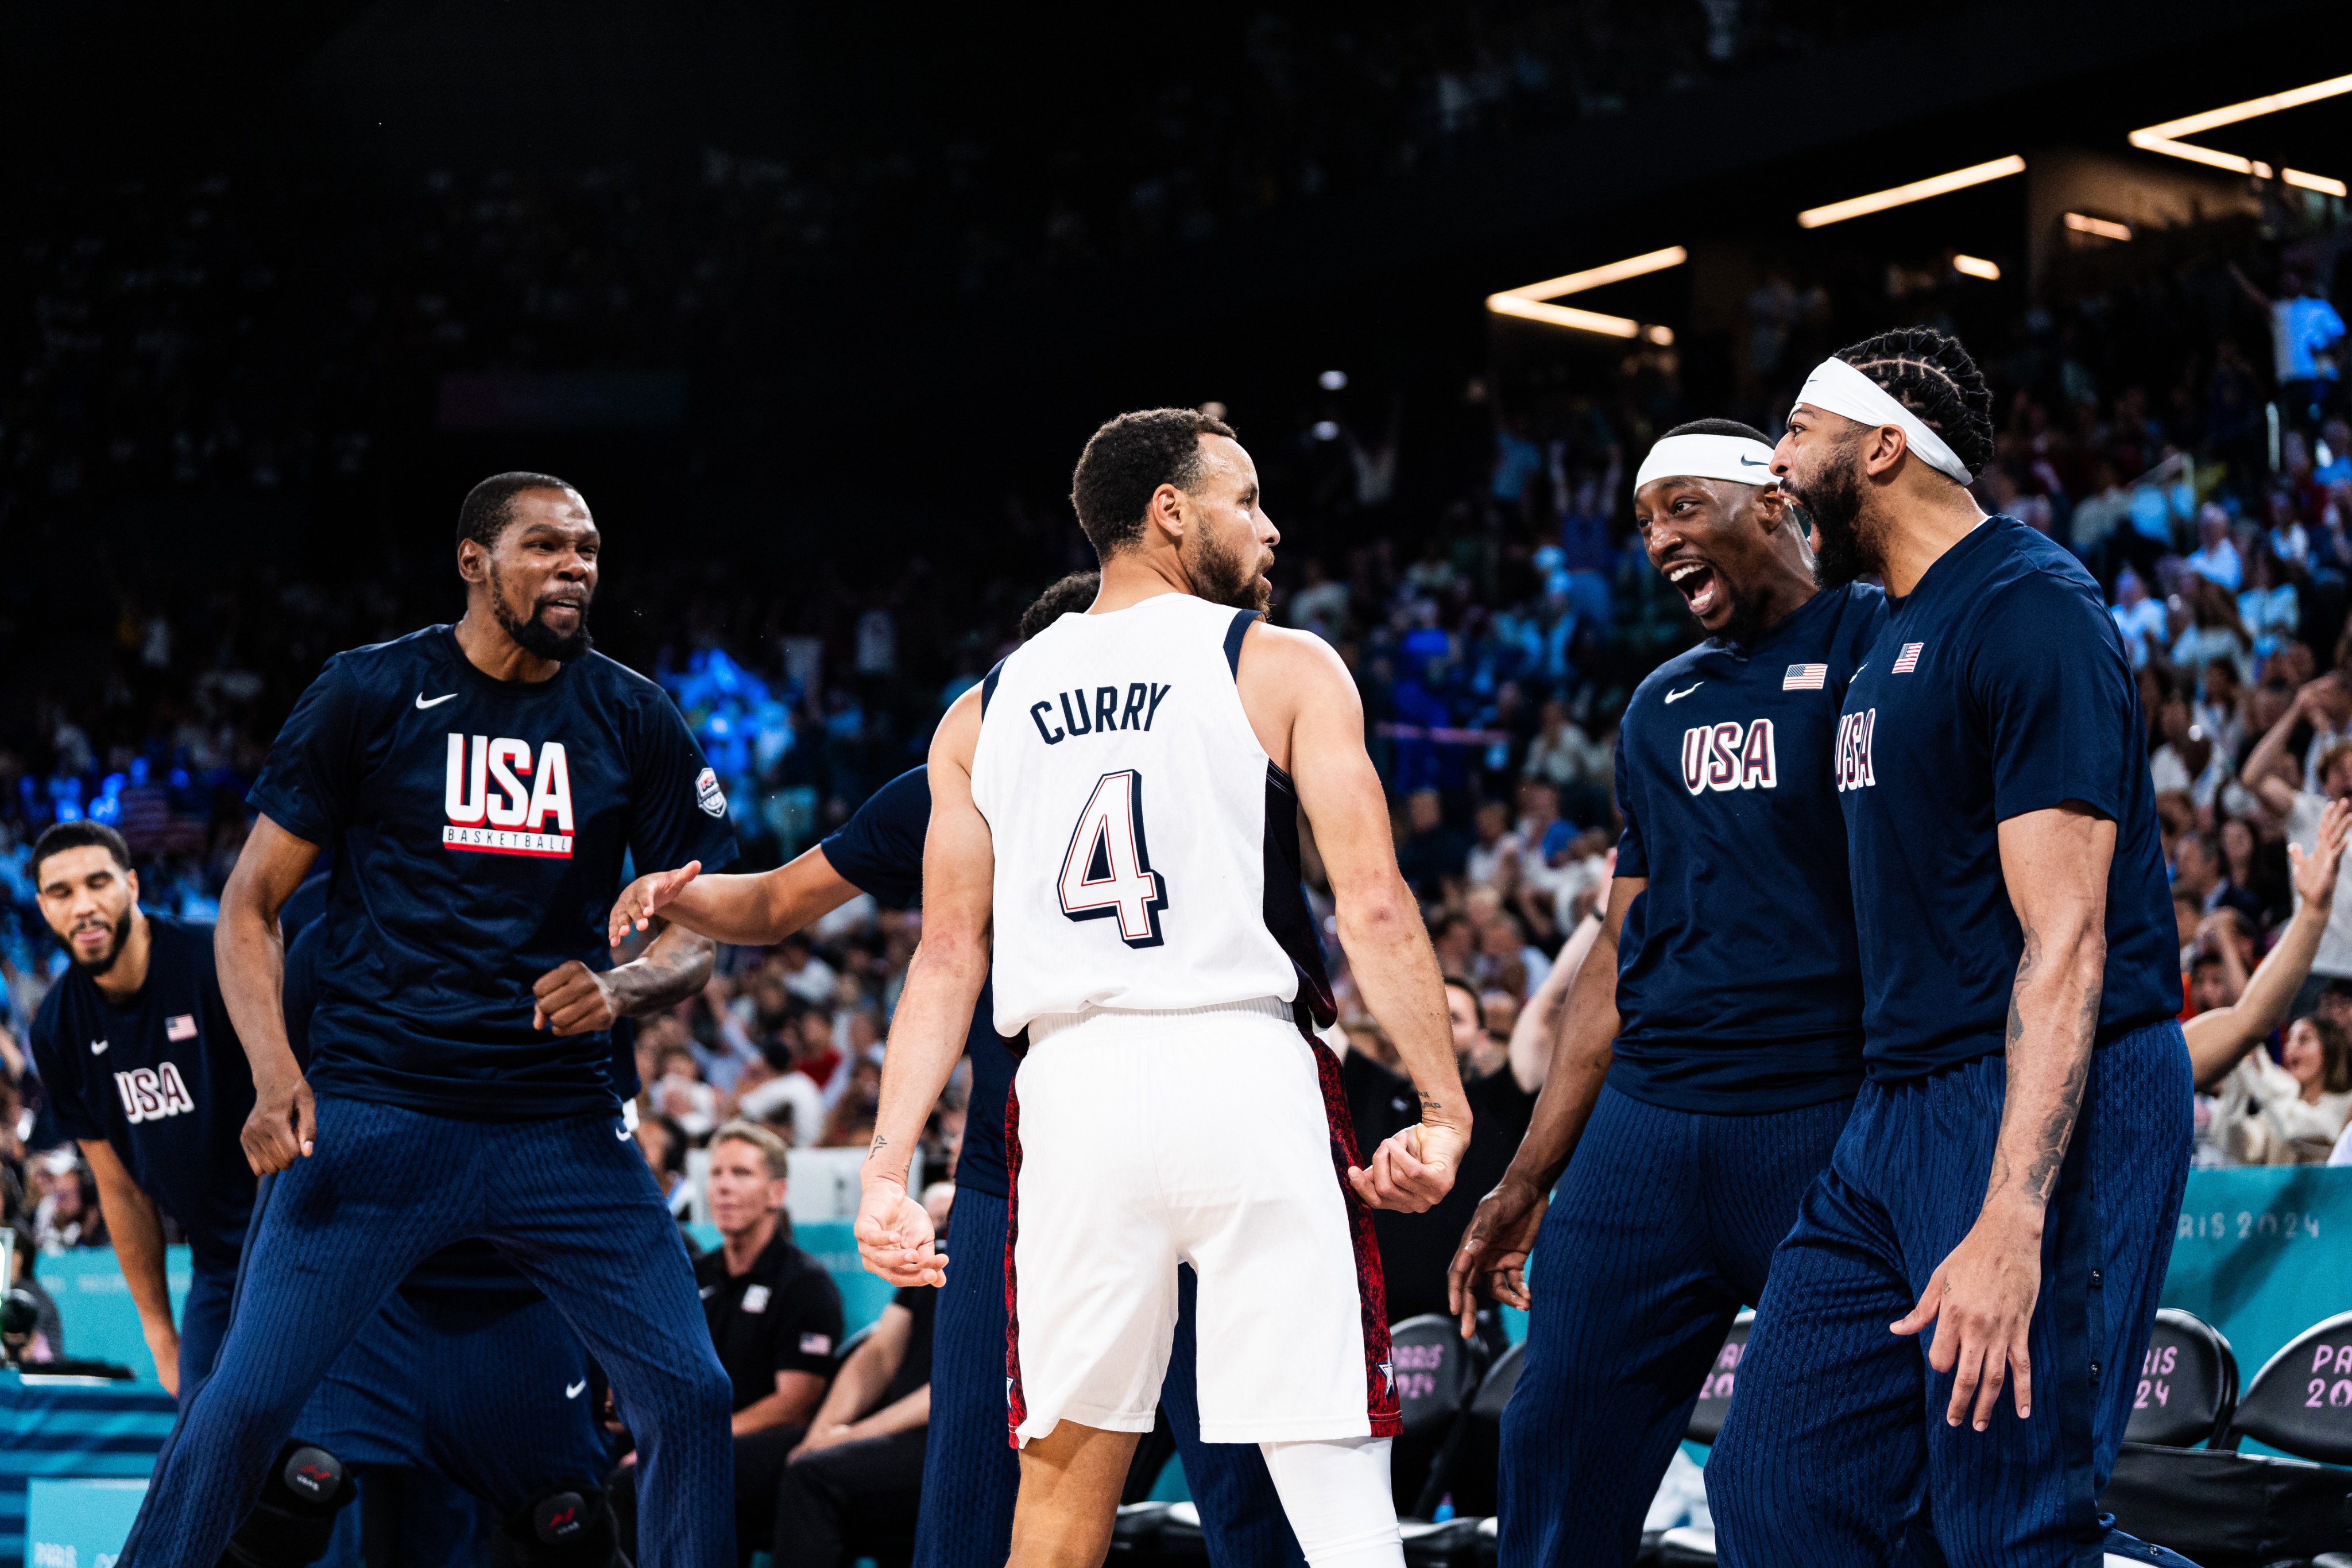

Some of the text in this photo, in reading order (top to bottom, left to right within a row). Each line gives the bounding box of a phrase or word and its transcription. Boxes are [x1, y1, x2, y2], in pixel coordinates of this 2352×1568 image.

[1030, 682, 1172, 745] CURRY
[1682, 718, 1777, 796] USA
[1835, 708, 1876, 792] USA
[444, 733, 575, 836] USA
[447, 828, 566, 851] BASKETBALL
[1057, 769, 1169, 949] 4
[113, 1062, 195, 1124] USA
[2177, 1212, 2224, 1240] RIS
[1699, 1372, 1735, 1399] 20
[2133, 1379, 2170, 1409] 24
[2305, 1378, 2352, 1408] 20
